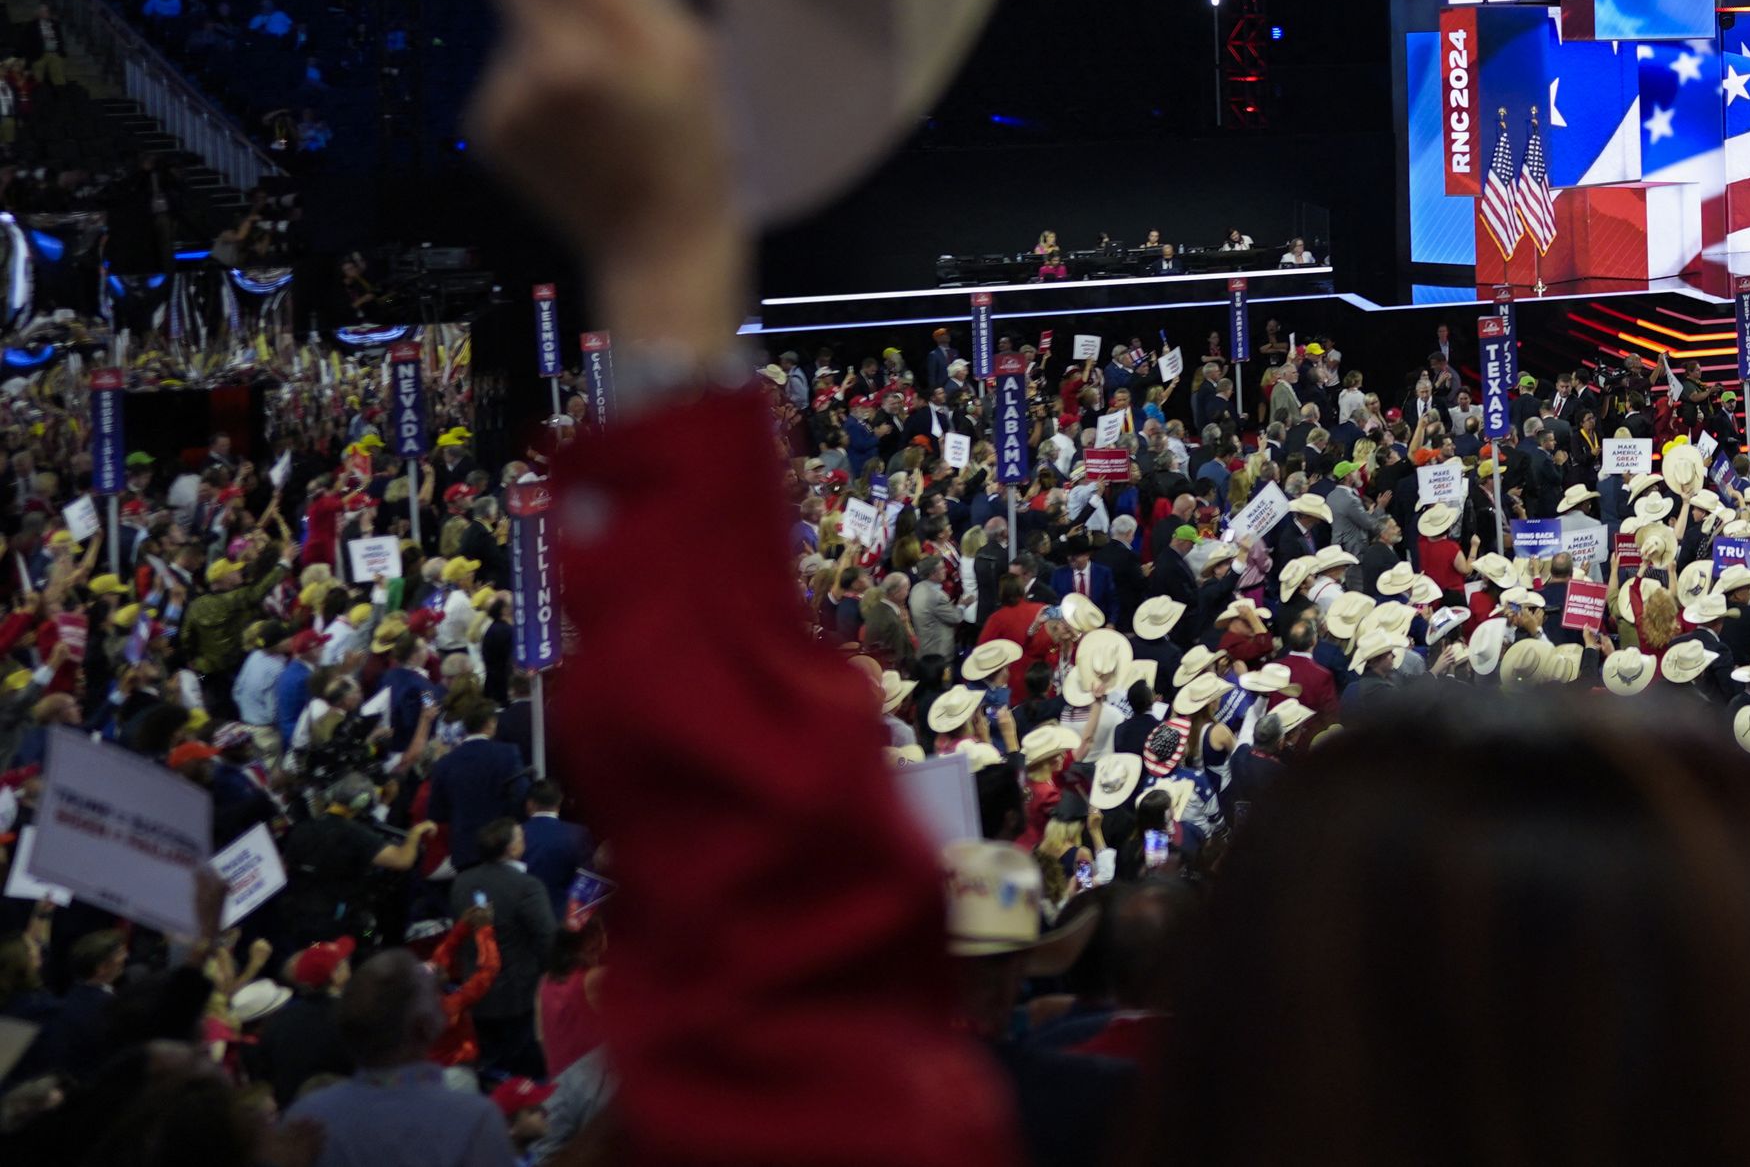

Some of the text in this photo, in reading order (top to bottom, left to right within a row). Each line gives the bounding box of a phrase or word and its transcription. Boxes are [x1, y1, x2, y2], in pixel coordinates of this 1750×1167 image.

[1448, 29, 1471, 174] RNC 2024
[540, 300, 555, 372] VERMONT
[979, 306, 989, 374] TENNESSEE
[1499, 305, 1511, 336] NEW
[1742, 294, 1750, 321] WEST
[397, 363, 419, 453] NEVADA
[1486, 343, 1503, 430] TEXAS
[1003, 376, 1021, 478] ALABAMA
[1567, 540, 1599, 550] AMERICA
[1572, 547, 1595, 555] GREAT
[1573, 535, 1593, 543] MAKE
[1717, 545, 1745, 558] TRU
[513, 519, 527, 662] ILLINOIS
[537, 517, 553, 661] ILLINOIS
